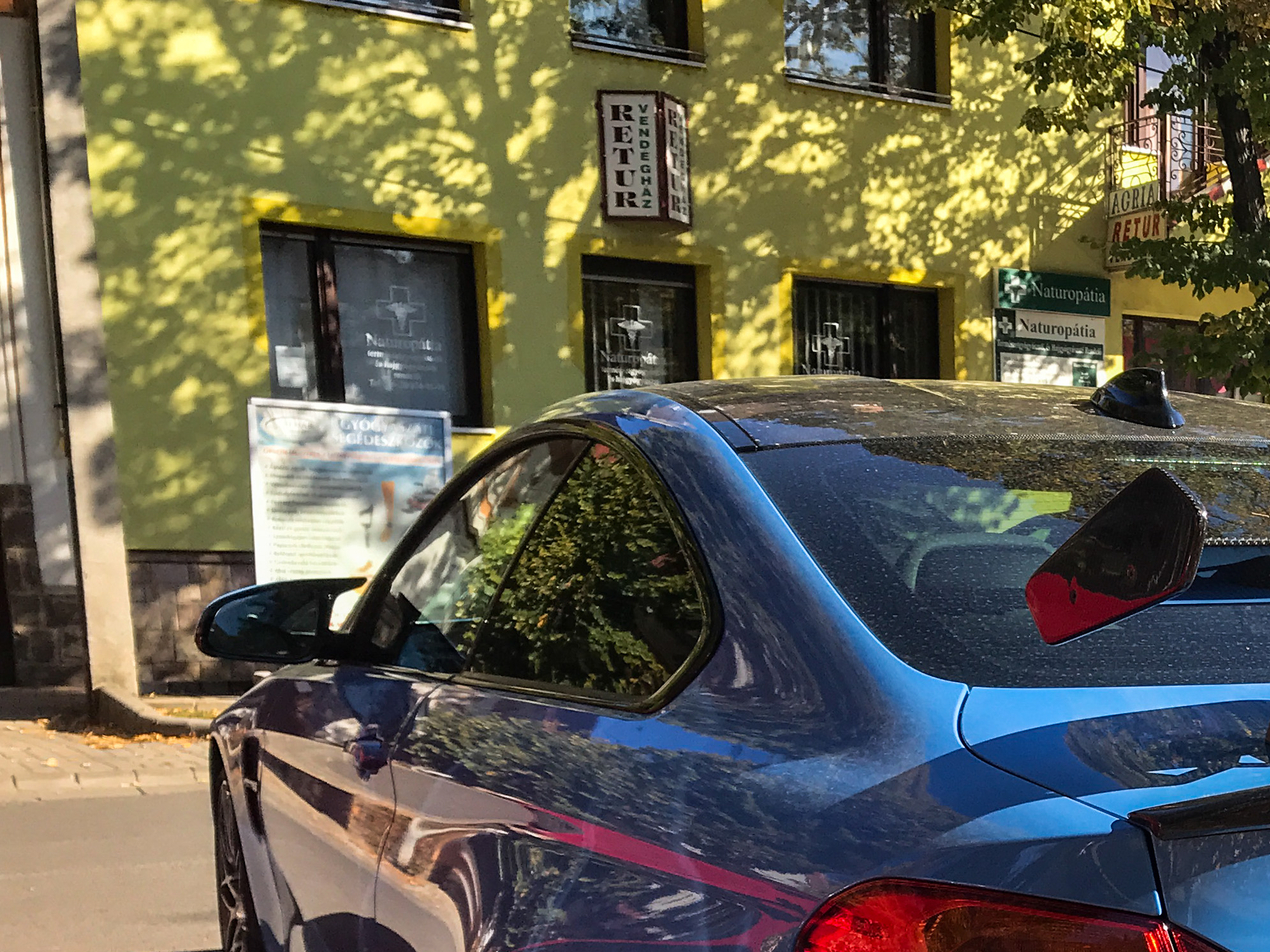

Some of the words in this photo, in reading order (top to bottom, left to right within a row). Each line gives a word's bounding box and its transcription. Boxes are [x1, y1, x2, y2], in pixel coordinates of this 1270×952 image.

[610, 104, 639, 208] RETUR
[1111, 184, 1154, 215] AGRIA
[1112, 213, 1161, 243] RETUR
[1032, 281, 1105, 304] Naturopátia
[1019, 318, 1096, 339] Naturopátia
